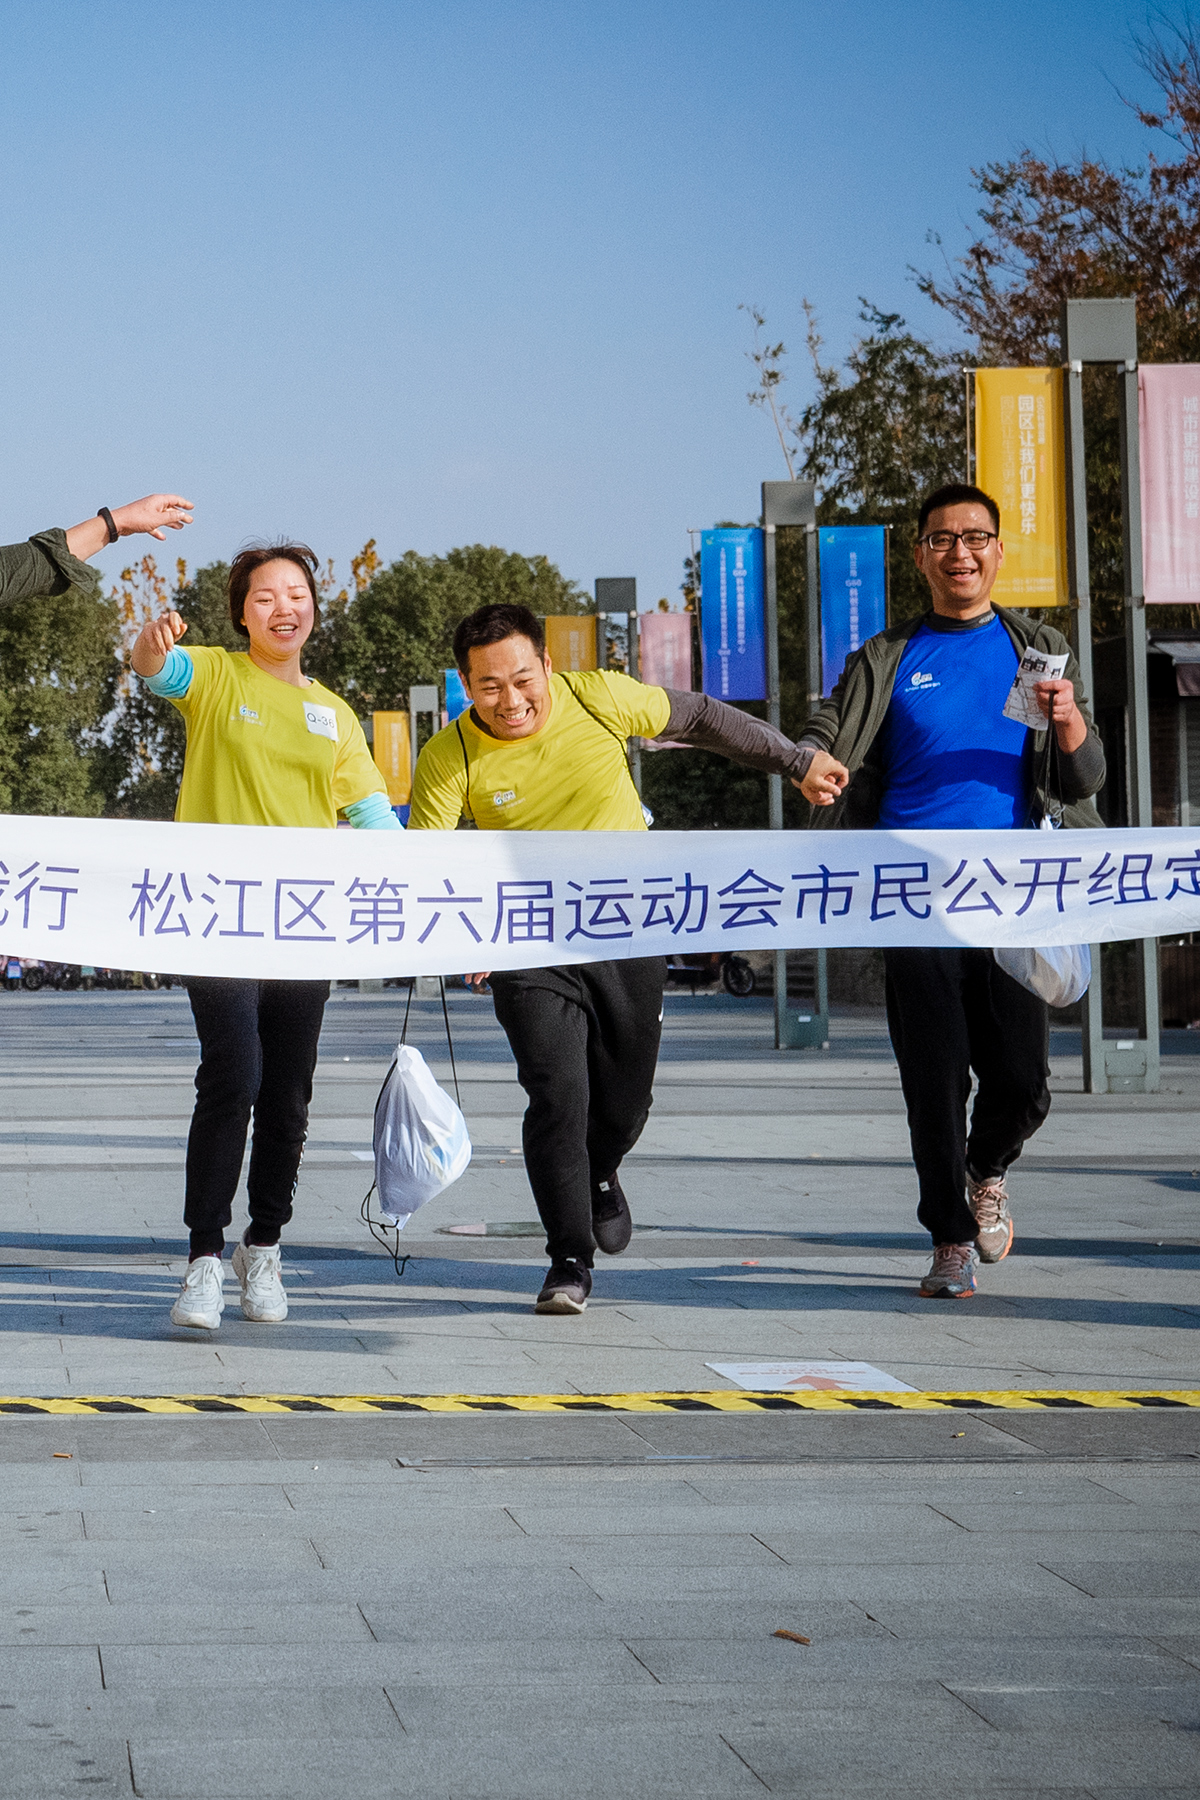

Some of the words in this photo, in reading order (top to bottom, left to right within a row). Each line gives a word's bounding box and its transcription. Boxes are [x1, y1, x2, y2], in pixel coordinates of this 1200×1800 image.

[1018, 394, 1037, 535] 园区让我们更快乐
[1183, 396, 1200, 518] 城市更新建设者
[306, 712, 336, 729] Q-36
